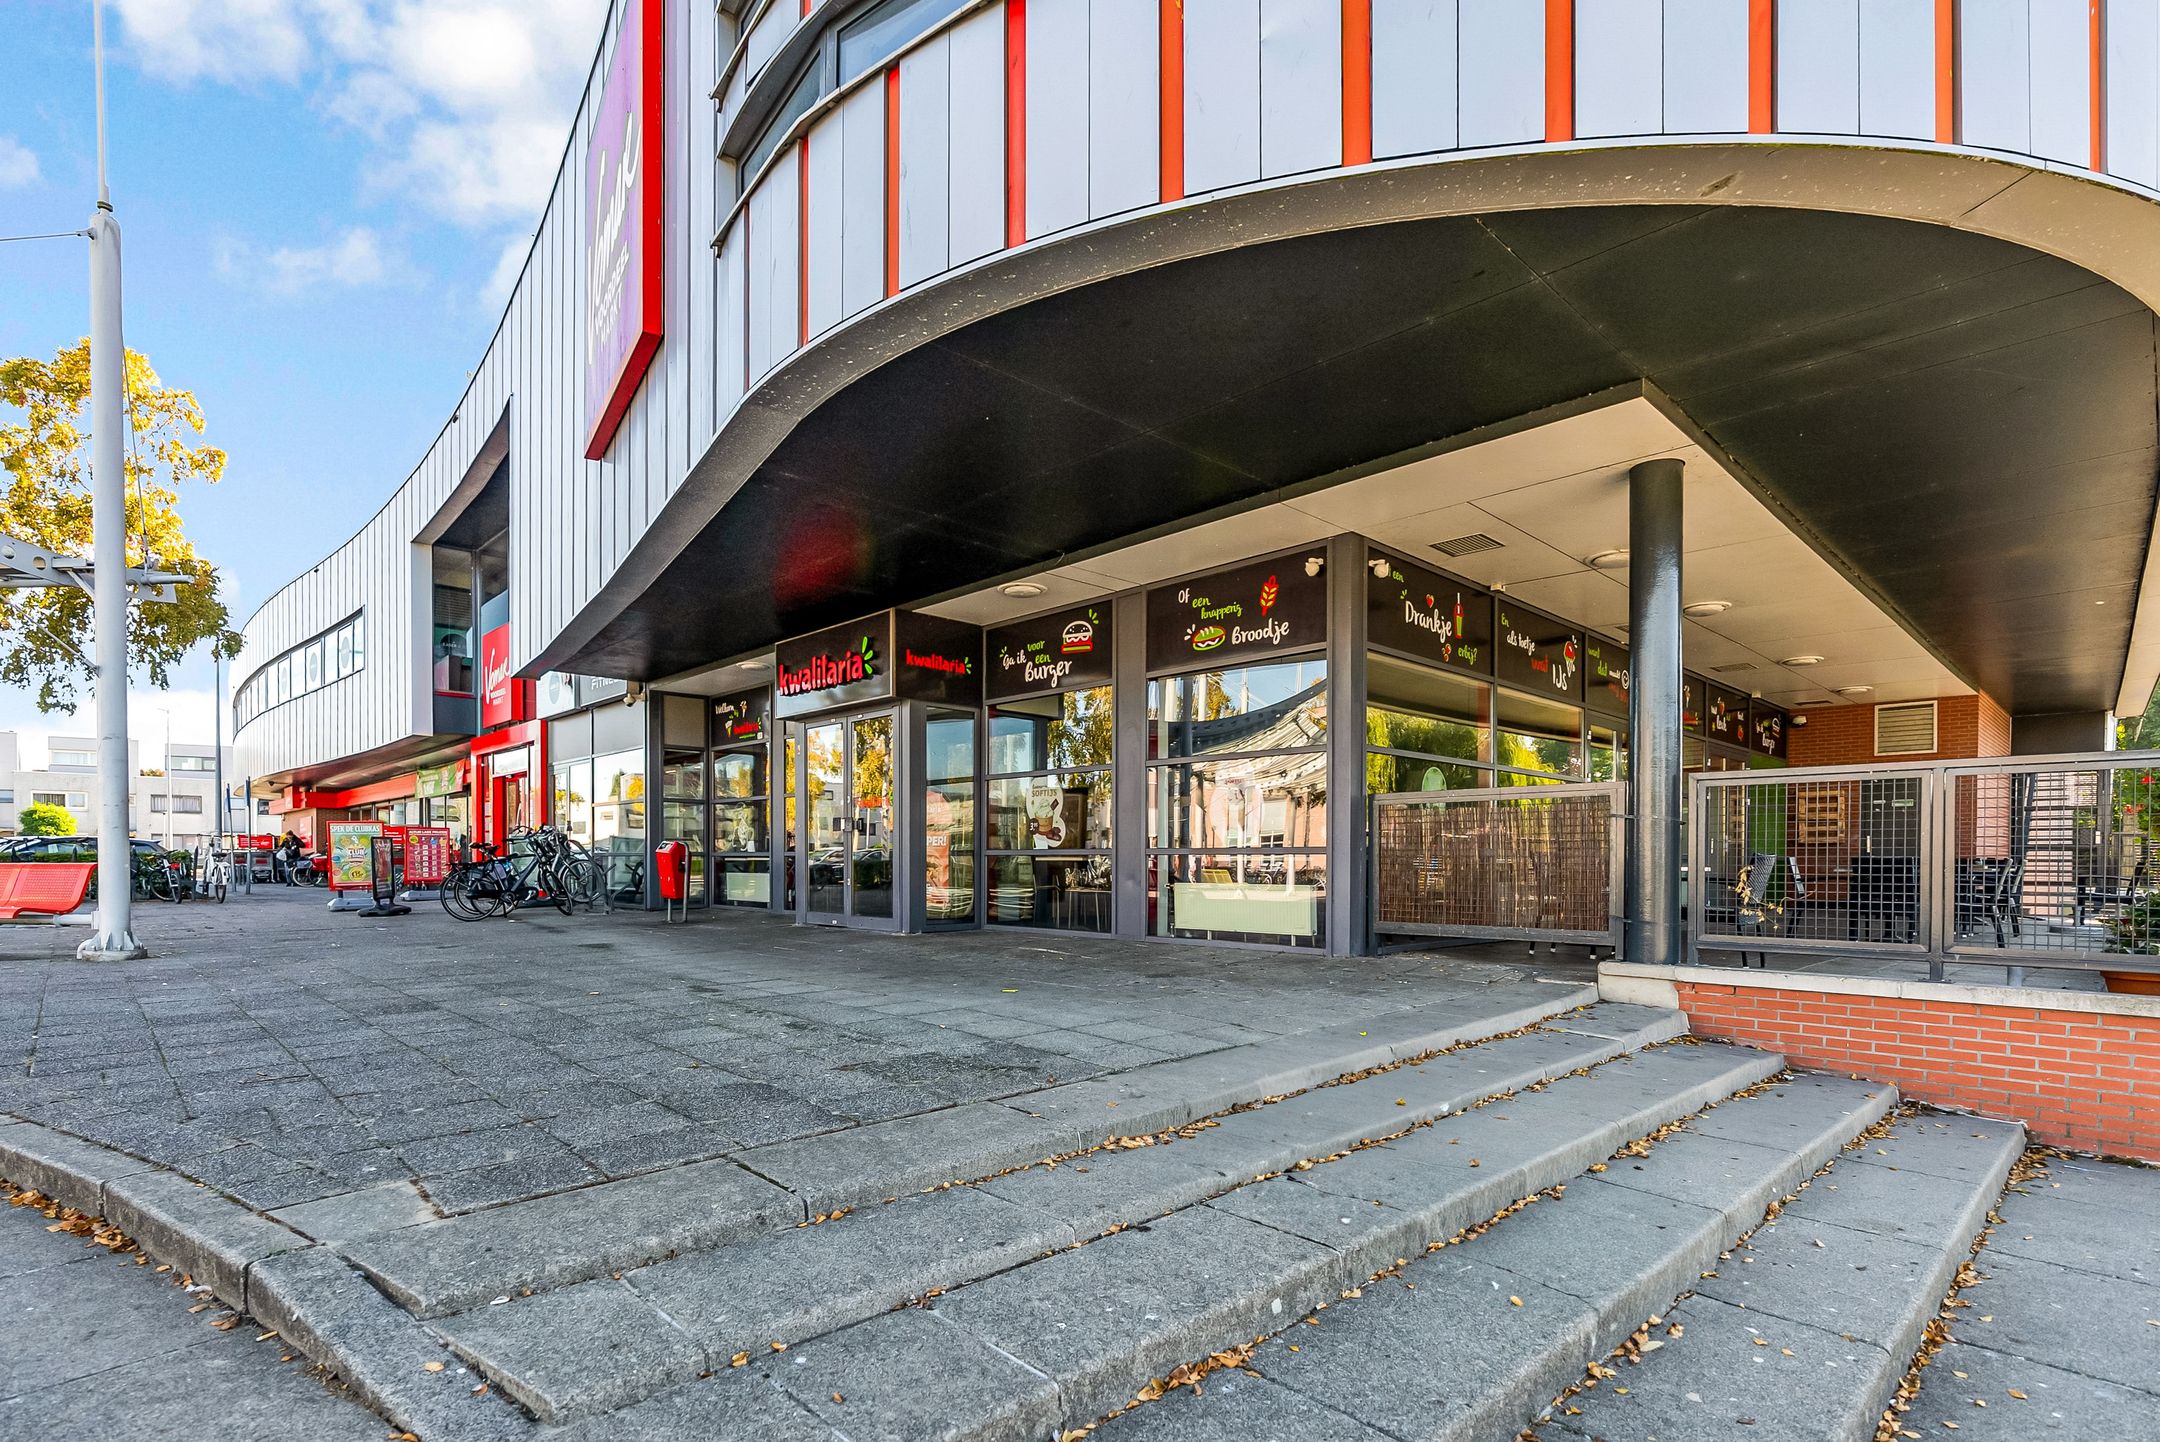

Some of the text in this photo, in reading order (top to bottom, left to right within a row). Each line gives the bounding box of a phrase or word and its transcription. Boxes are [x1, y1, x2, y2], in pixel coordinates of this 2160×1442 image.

[1178, 588, 1190, 604] Of
[1192, 598, 1211, 608] een
[1201, 602, 1242, 620] knapperig
[1405, 600, 1452, 643] Drankje
[1027, 641, 1045, 651] voor
[1507, 630, 1535, 656] als toetje
[906, 649, 966, 675] kwalitaria
[1002, 649, 1027, 670] Ga ik
[1035, 654, 1051, 664] een
[1458, 644, 1477, 665] erbij?
[779, 650, 864, 696] kwalitaria
[1552, 663, 1567, 691] IJs
[1031, 789, 1058, 798] SOFTIJS
